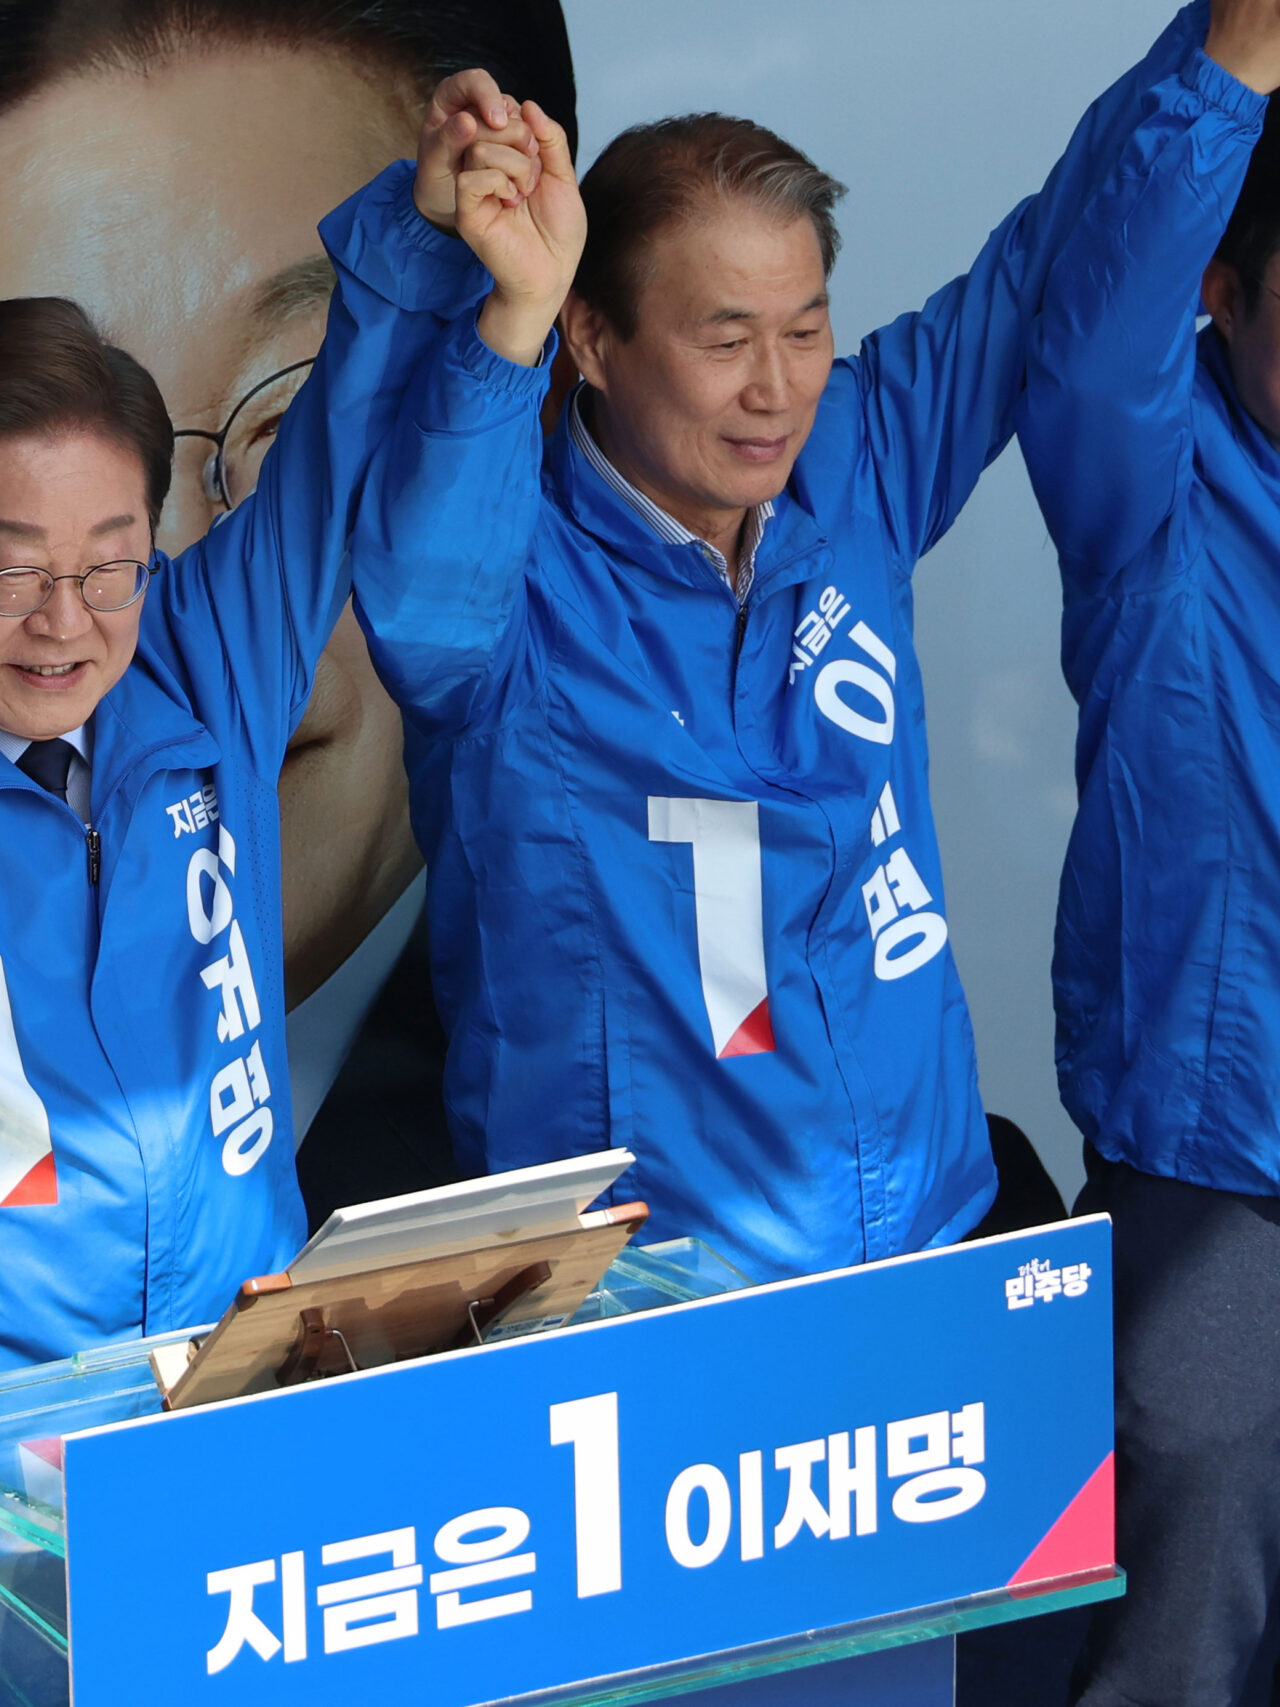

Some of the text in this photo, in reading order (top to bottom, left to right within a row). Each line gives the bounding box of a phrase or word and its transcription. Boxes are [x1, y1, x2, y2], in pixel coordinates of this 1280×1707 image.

[789, 585, 852, 686] 지금은
[165, 784, 220, 839] 지금은
[186, 823, 274, 1177] 이재명
[647, 795, 777, 1059] 1
[1005, 1262, 1092, 1311] 민주당
[206, 1391, 987, 1675] 지금은 1 이재명
